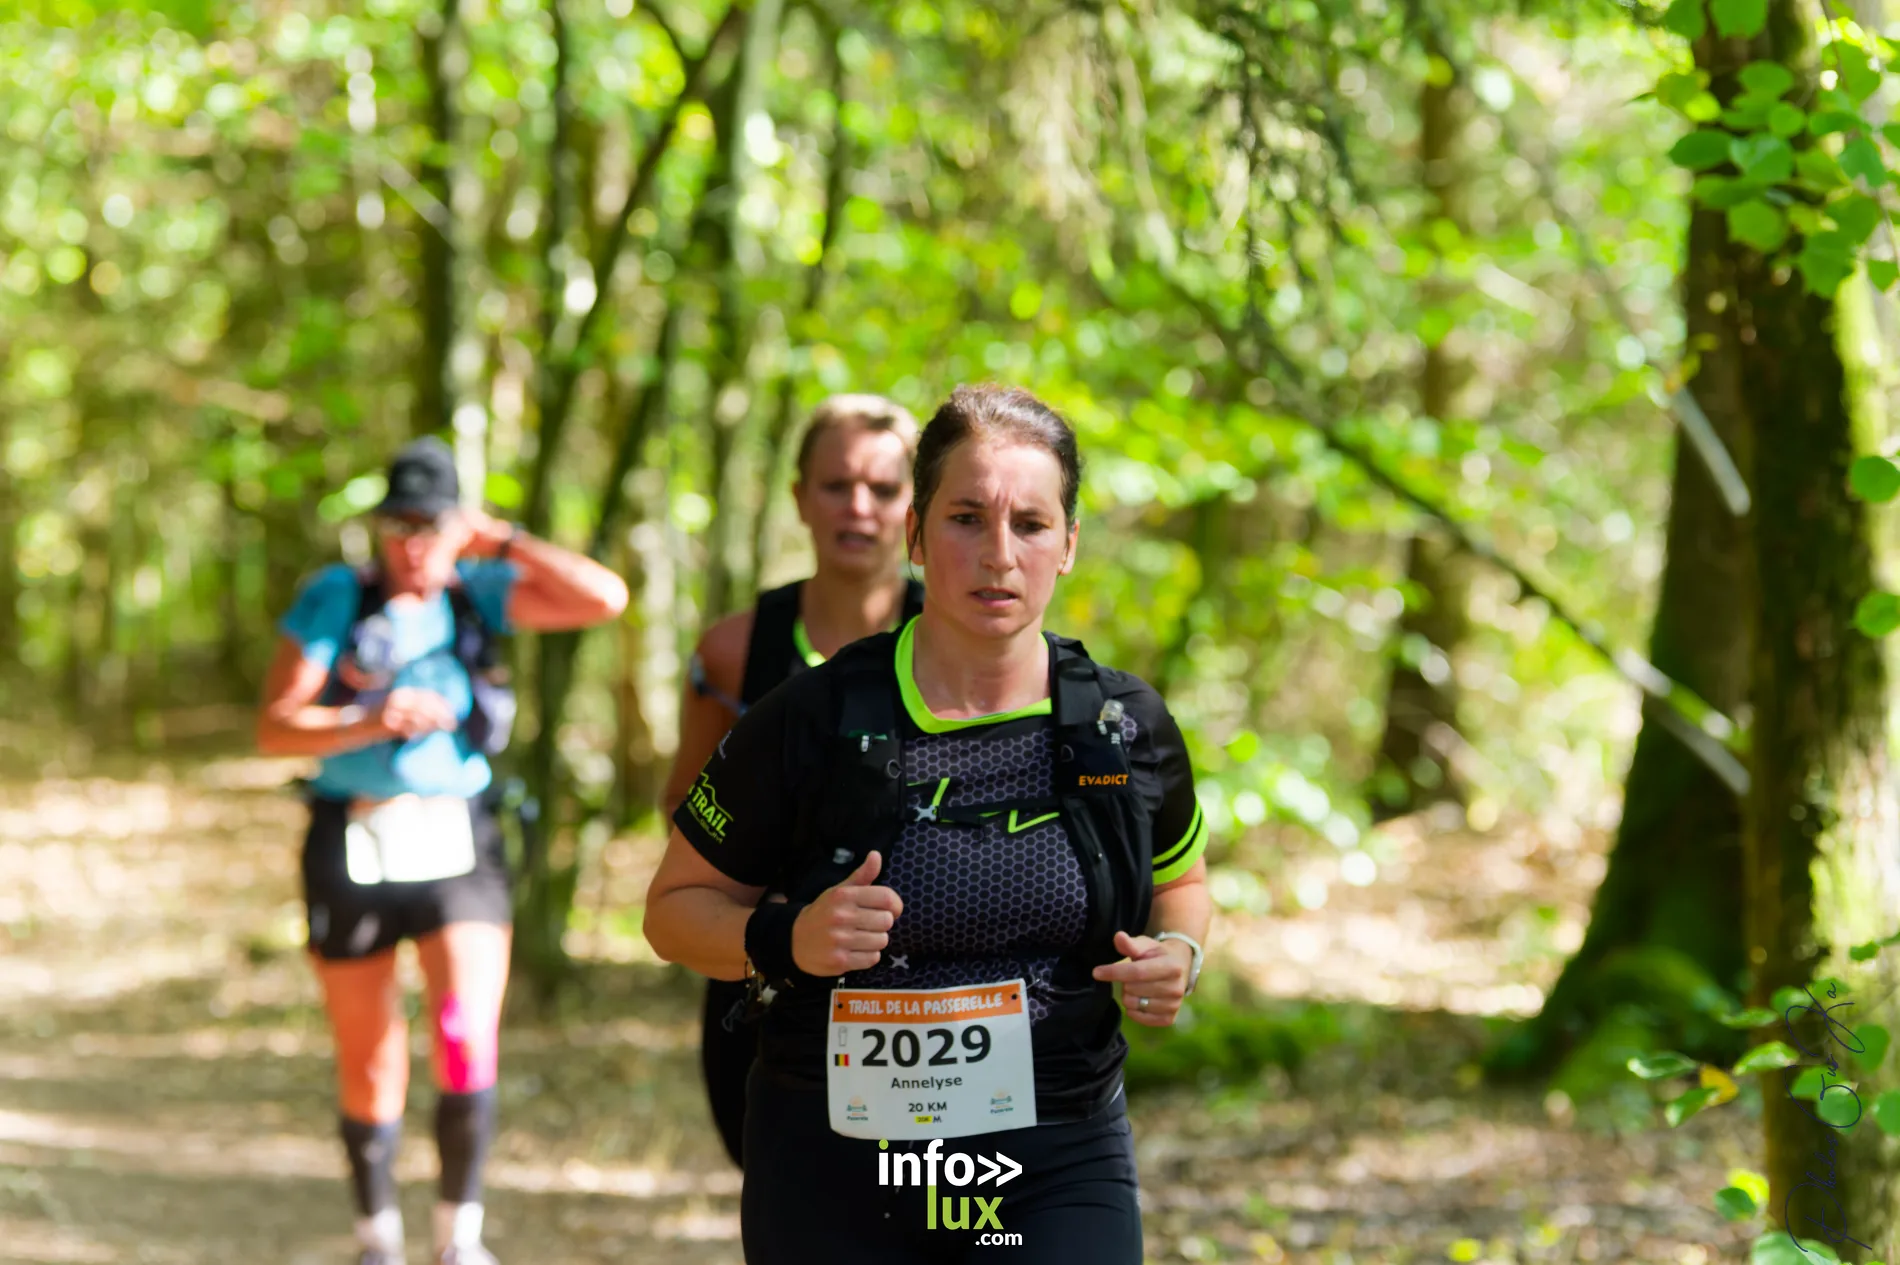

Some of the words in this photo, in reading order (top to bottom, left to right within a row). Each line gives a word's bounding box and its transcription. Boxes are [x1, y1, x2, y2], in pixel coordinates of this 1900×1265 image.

[1079, 774, 1129, 786] EVADICT
[692, 786, 727, 838] TRAIL
[848, 999, 883, 1015] TRAIL
[886, 1000, 901, 1015] DE
[904, 1000, 920, 1015] LA
[923, 992, 1003, 1015] PASSERELLE
[861, 1025, 991, 1067] 2029
[891, 1076, 963, 1090] Annelyse
[909, 1103, 923, 1112] 20
[928, 1102, 947, 1111] KM
